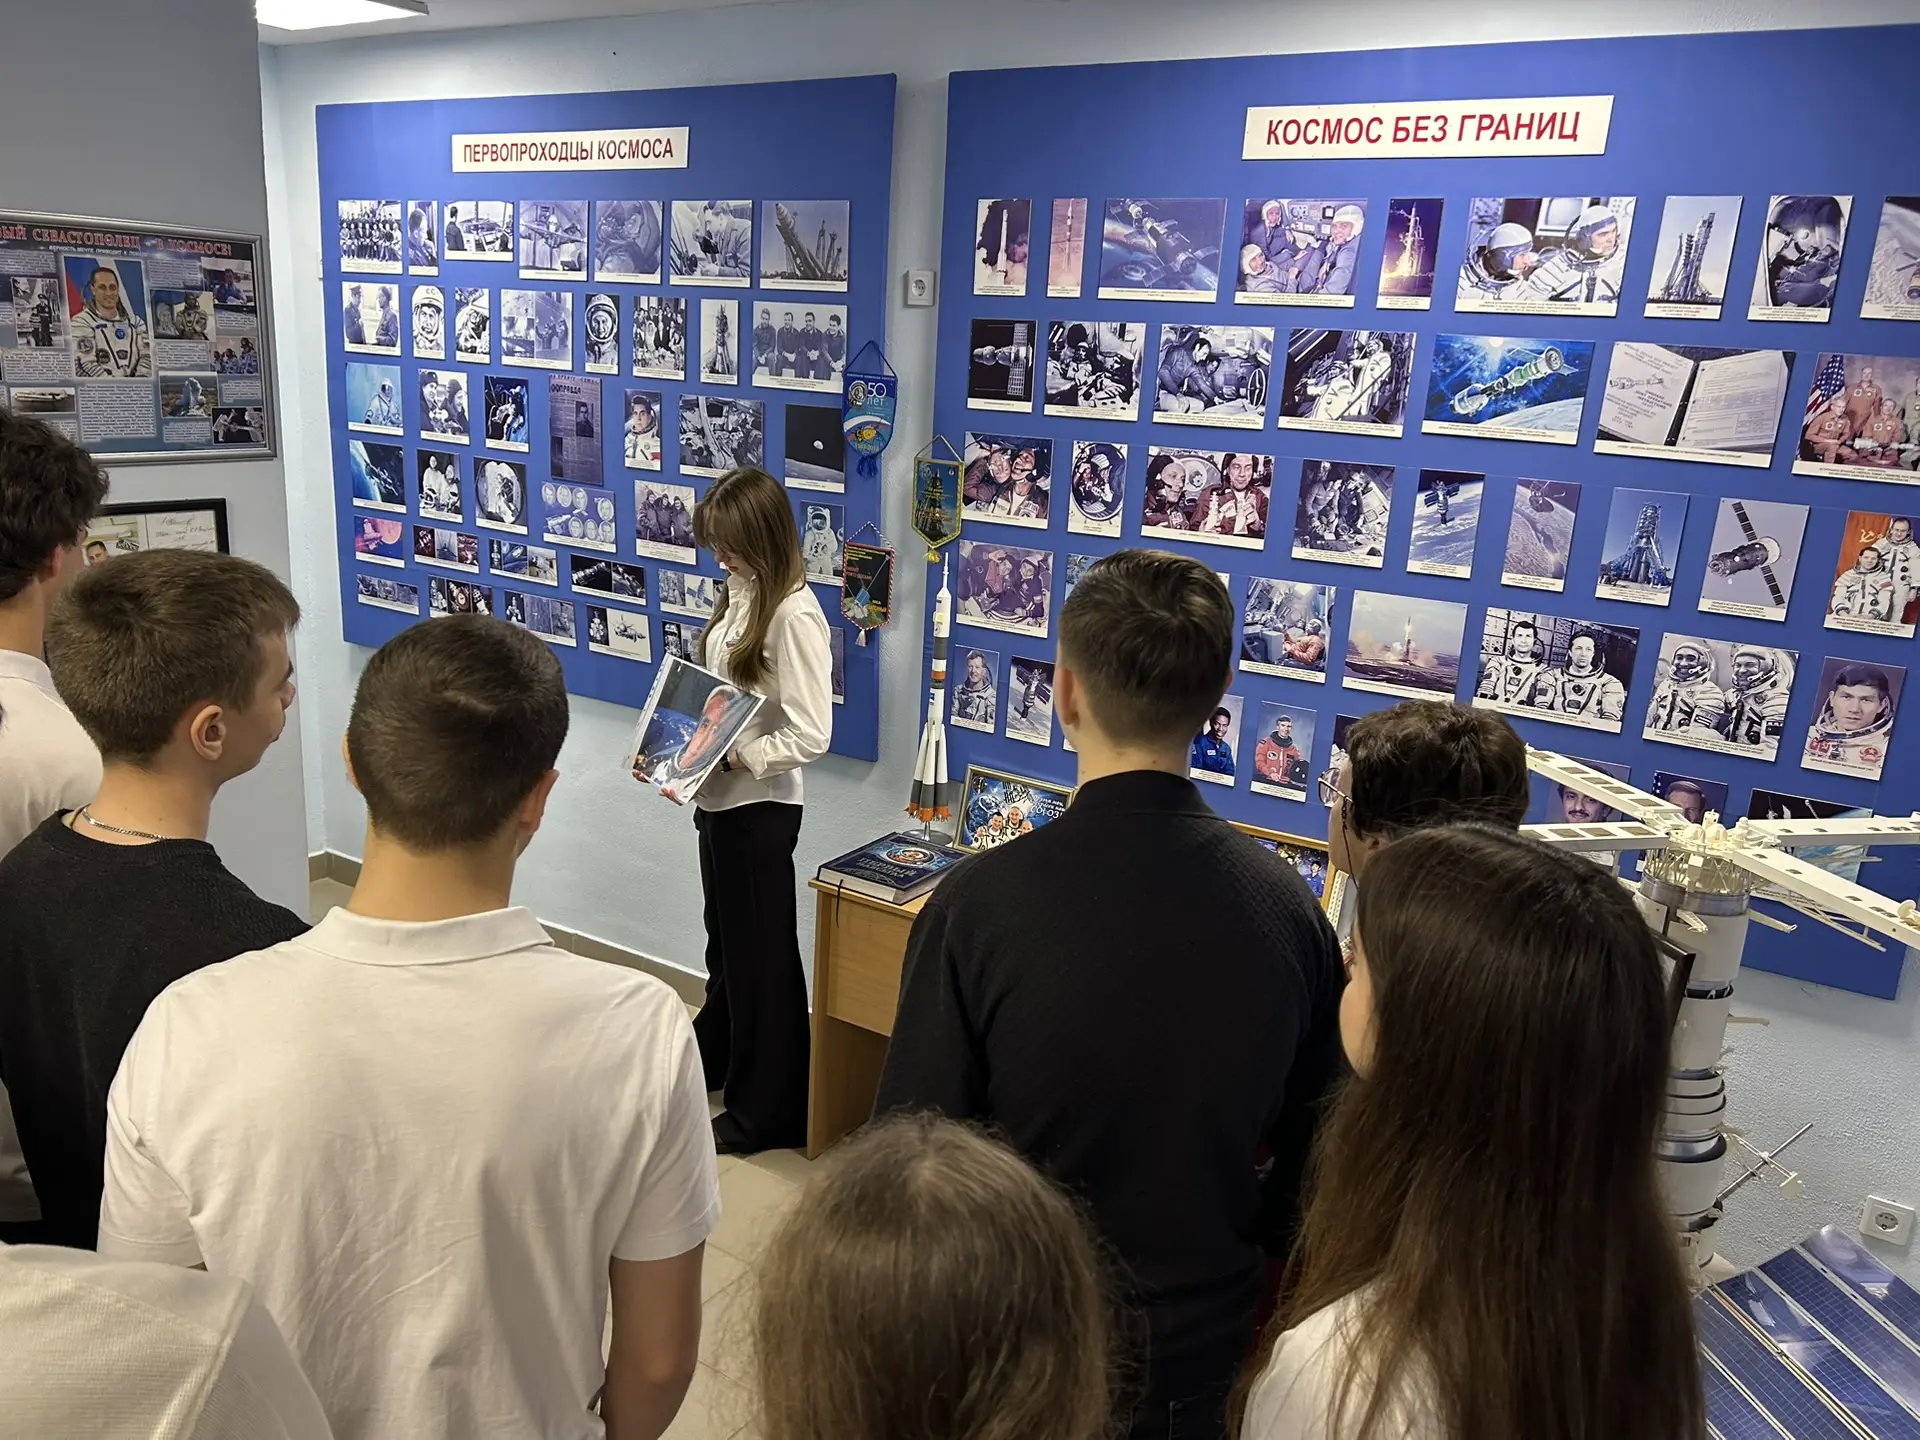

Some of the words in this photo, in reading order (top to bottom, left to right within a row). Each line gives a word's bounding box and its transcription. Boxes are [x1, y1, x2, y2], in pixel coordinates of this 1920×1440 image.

[1266, 116, 1384, 146] КОСМОС
[1392, 115, 1449, 144] БЕЗ
[1457, 111, 1581, 142] ГРАНИЦ
[463, 141, 594, 164] ПЕРВОПРОХОДЦЫ
[597, 138, 674, 161] КОСМОСА
[0, 224, 27, 240] ЫЙ
[32, 228, 141, 250] СЕВАСТОПОЛЕЦ
[866, 398, 884, 407] лет
[867, 382, 887, 398] 50
